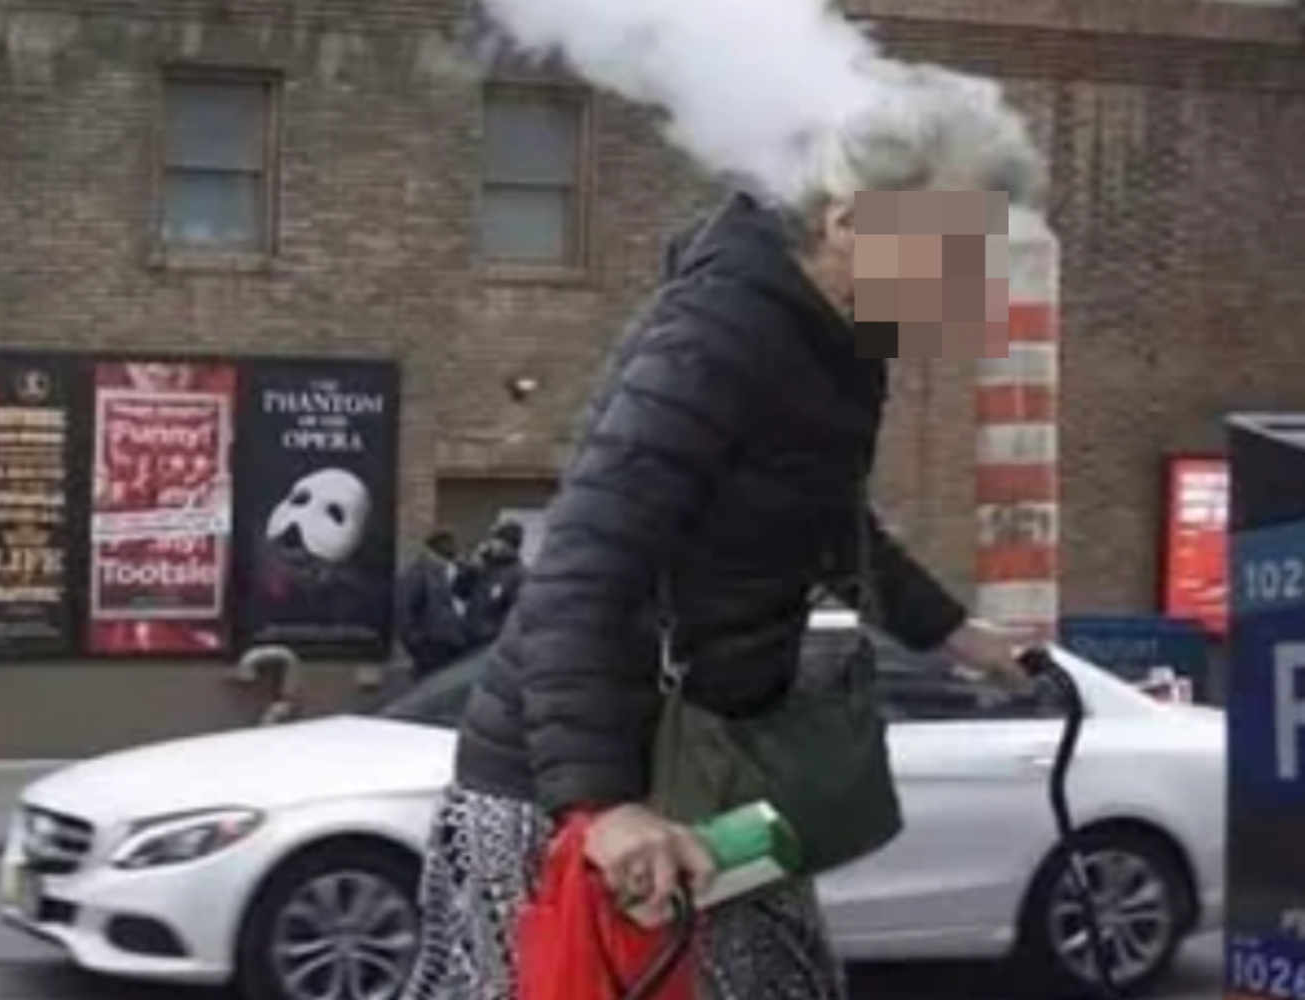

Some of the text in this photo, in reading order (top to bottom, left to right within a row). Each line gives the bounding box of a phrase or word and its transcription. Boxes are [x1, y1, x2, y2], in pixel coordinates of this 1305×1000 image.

[262, 390, 384, 414] PHANTOM
[281, 430, 365, 452] OPERA
[98, 557, 215, 586] Tootsie
